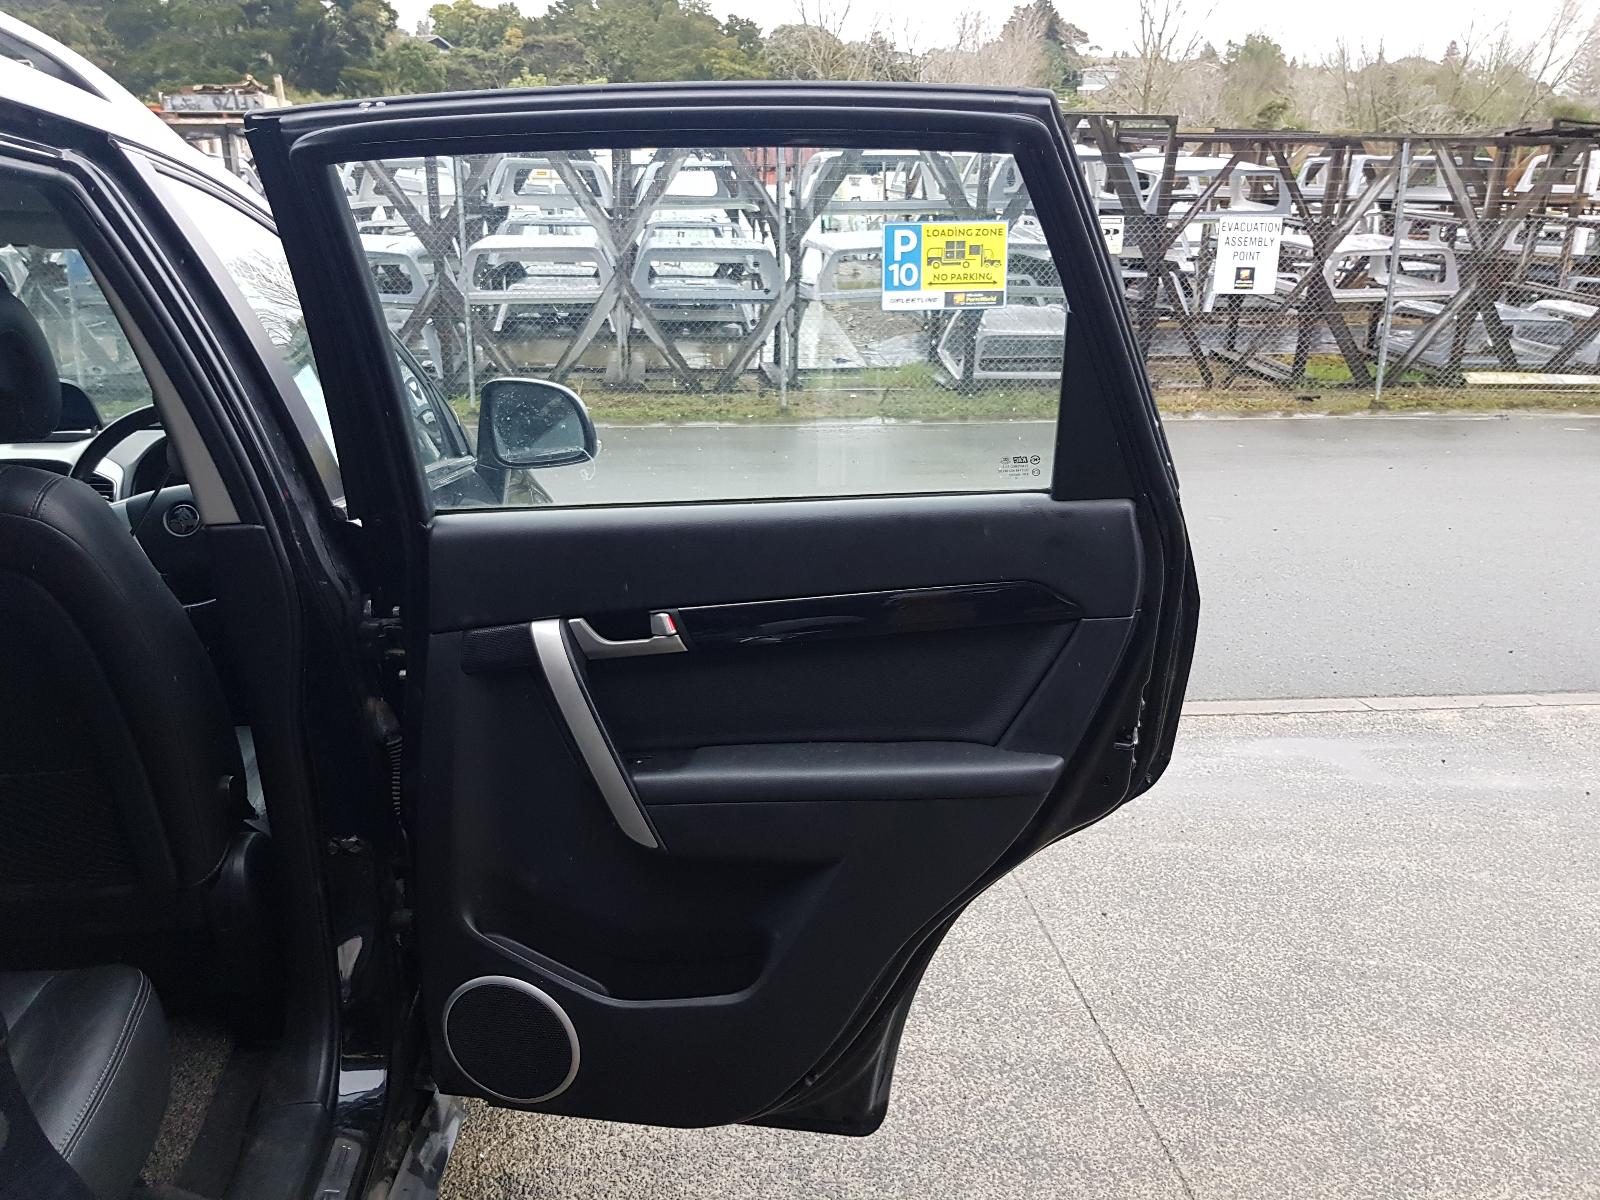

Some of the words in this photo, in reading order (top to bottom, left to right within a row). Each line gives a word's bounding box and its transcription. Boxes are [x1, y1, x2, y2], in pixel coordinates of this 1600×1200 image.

[1222, 222, 1280, 232] EVACUATION
[926, 227, 973, 238] LOADING
[975, 228, 1004, 236] ZONE
[893, 229, 918, 261] P
[1224, 237, 1275, 246] ASSEMBLY
[1232, 252, 1260, 260] POINT
[888, 262, 918, 286] 10
[933, 274, 948, 282] NO
[950, 273, 992, 281] PARKING
